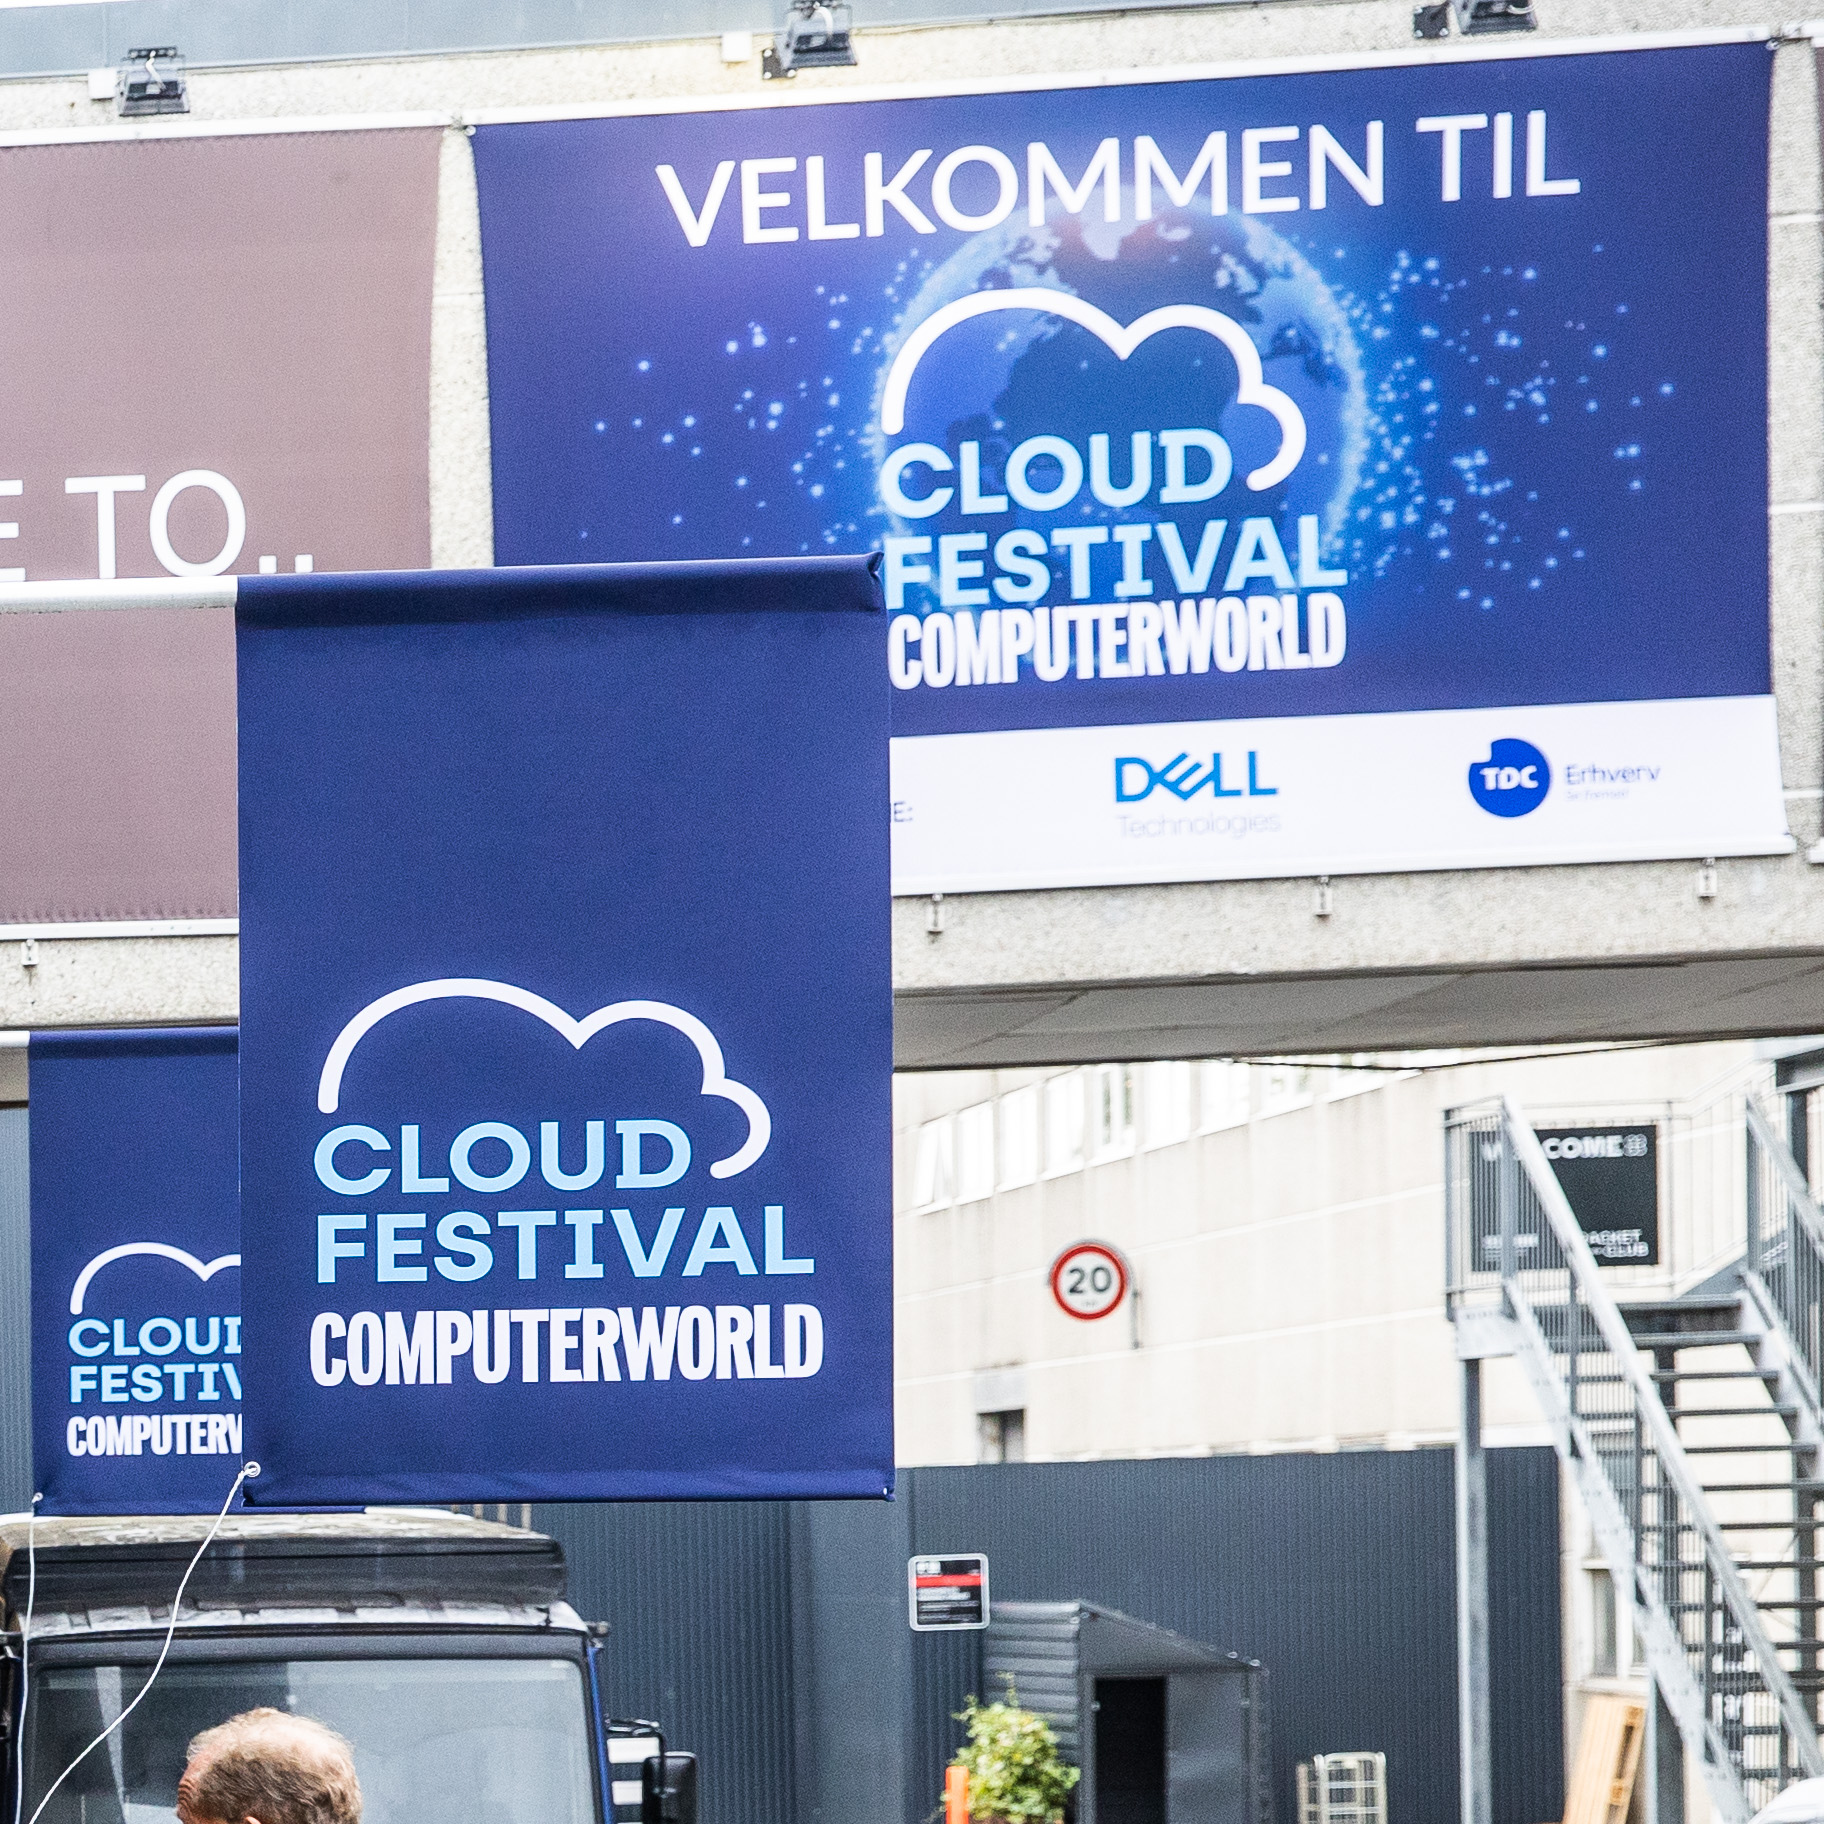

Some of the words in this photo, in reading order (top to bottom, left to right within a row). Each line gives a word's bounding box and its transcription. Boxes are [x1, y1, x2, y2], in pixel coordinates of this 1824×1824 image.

[655, 120, 1384, 247] VELKOMMEN
[1416, 110, 1581, 202] TIL
[880, 428, 1233, 519] CLOUD
[883, 514, 1348, 610] FESTIVAL
[888, 592, 1347, 690] COMPUTERWORLD
[1115, 751, 1279, 803] DELL
[1480, 765, 1539, 791] TDC
[1117, 812, 1282, 839] Technologies
[313, 1119, 692, 1196] CLOUD
[317, 1205, 815, 1285] FESTIVAL
[1068, 1266, 1112, 1294] 20
[309, 1303, 825, 1388] COMPUTERWORLD
